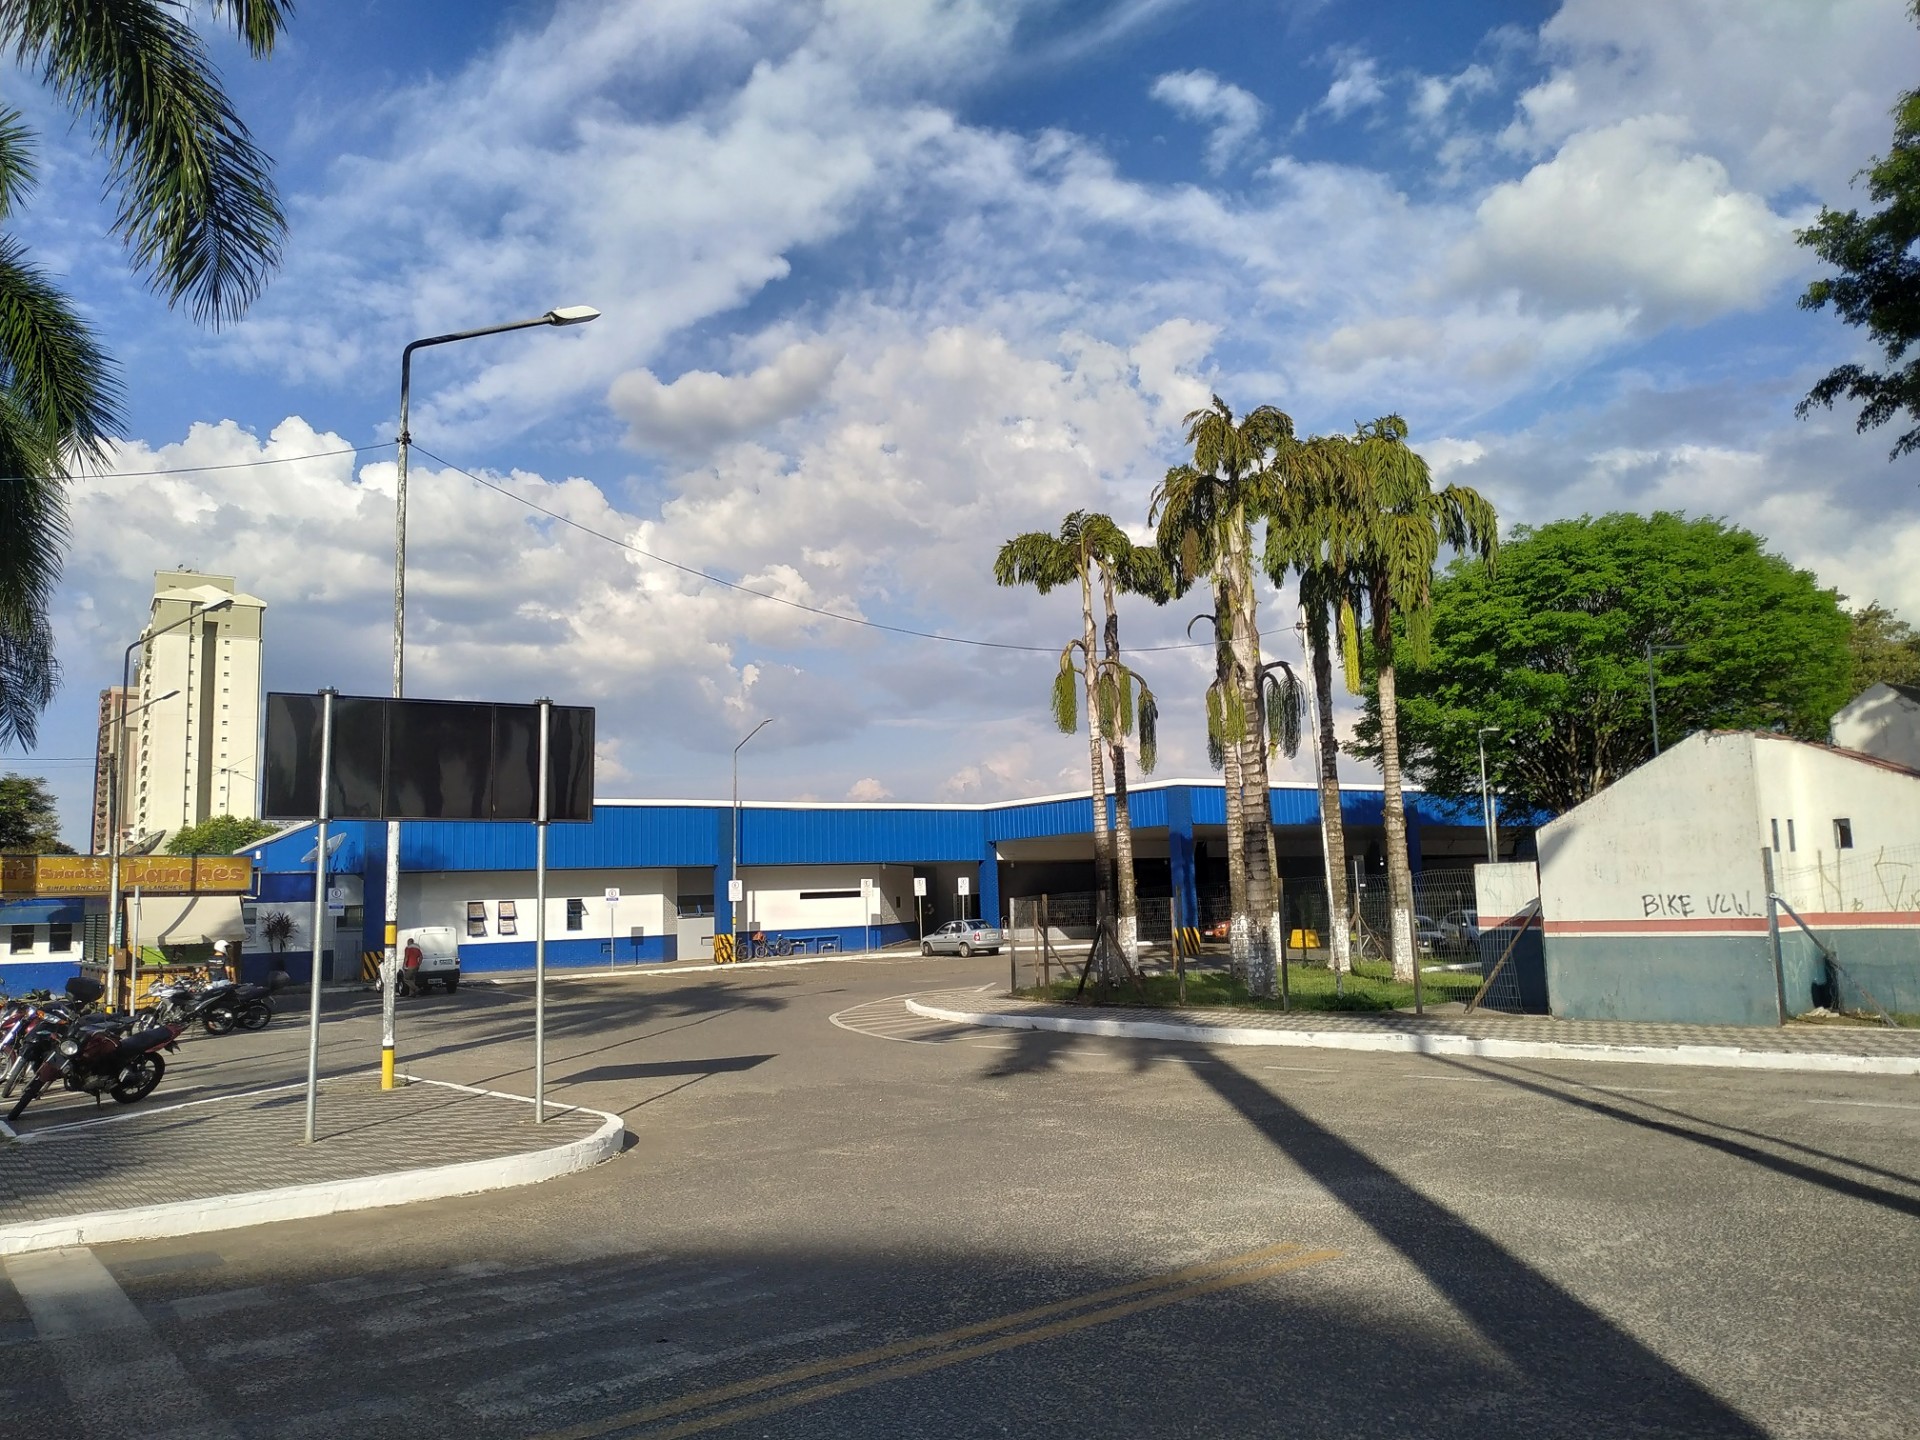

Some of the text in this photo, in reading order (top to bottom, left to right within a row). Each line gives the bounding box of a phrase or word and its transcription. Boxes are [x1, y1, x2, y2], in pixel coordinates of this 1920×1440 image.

[40, 867, 106, 880] Snacks
[125, 863, 246, 882] Lanches
[1642, 893, 1695, 917] BIKE
